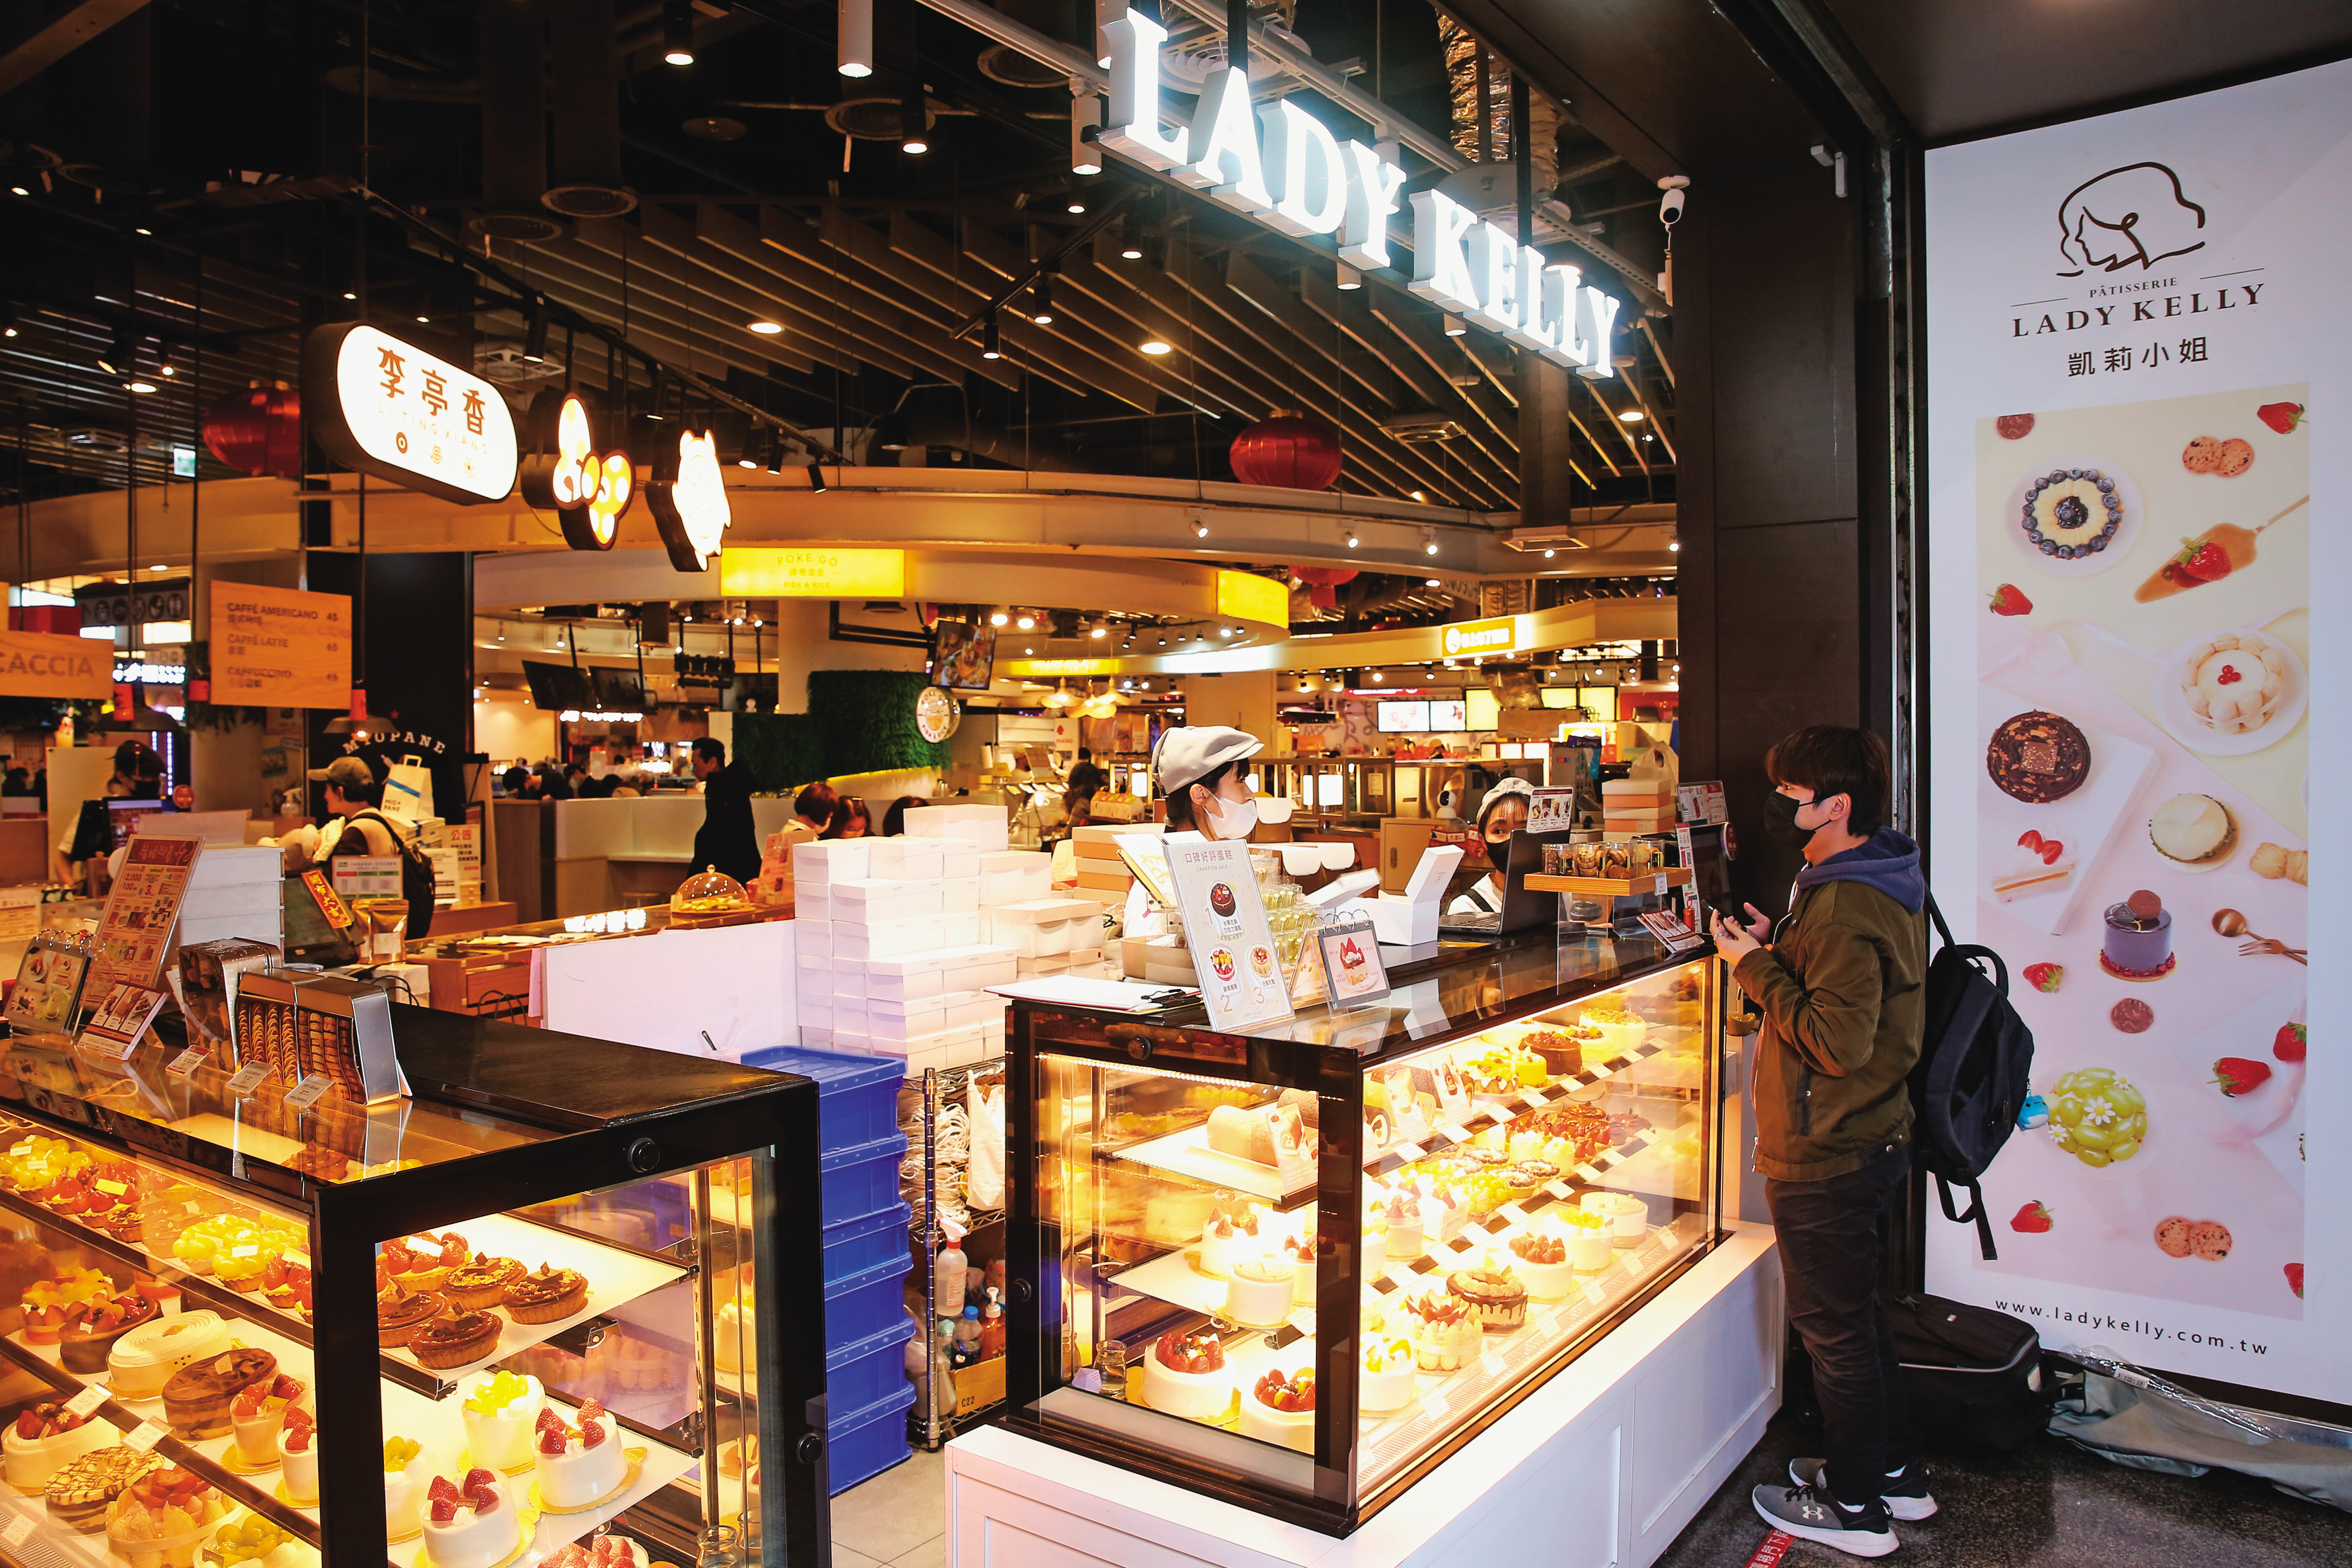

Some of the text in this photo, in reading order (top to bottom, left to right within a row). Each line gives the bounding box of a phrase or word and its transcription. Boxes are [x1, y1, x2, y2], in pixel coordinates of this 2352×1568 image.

[1122, 6, 1621, 379] LADY KELLY
[2089, 277, 2178, 298] PÂTISSERIE
[2012, 283, 2265, 337] LADY KELLY
[2068, 337, 2208, 377] 凱莉小姐
[377, 345, 486, 436] 李亭香
[777, 553, 838, 566] POKE GO
[260, 606, 318, 620] AMERICANO
[1184, 849, 1233, 863] 口碑好評蛋糕
[1995, 1299, 2268, 1356] www.ladykelly.com.tw
